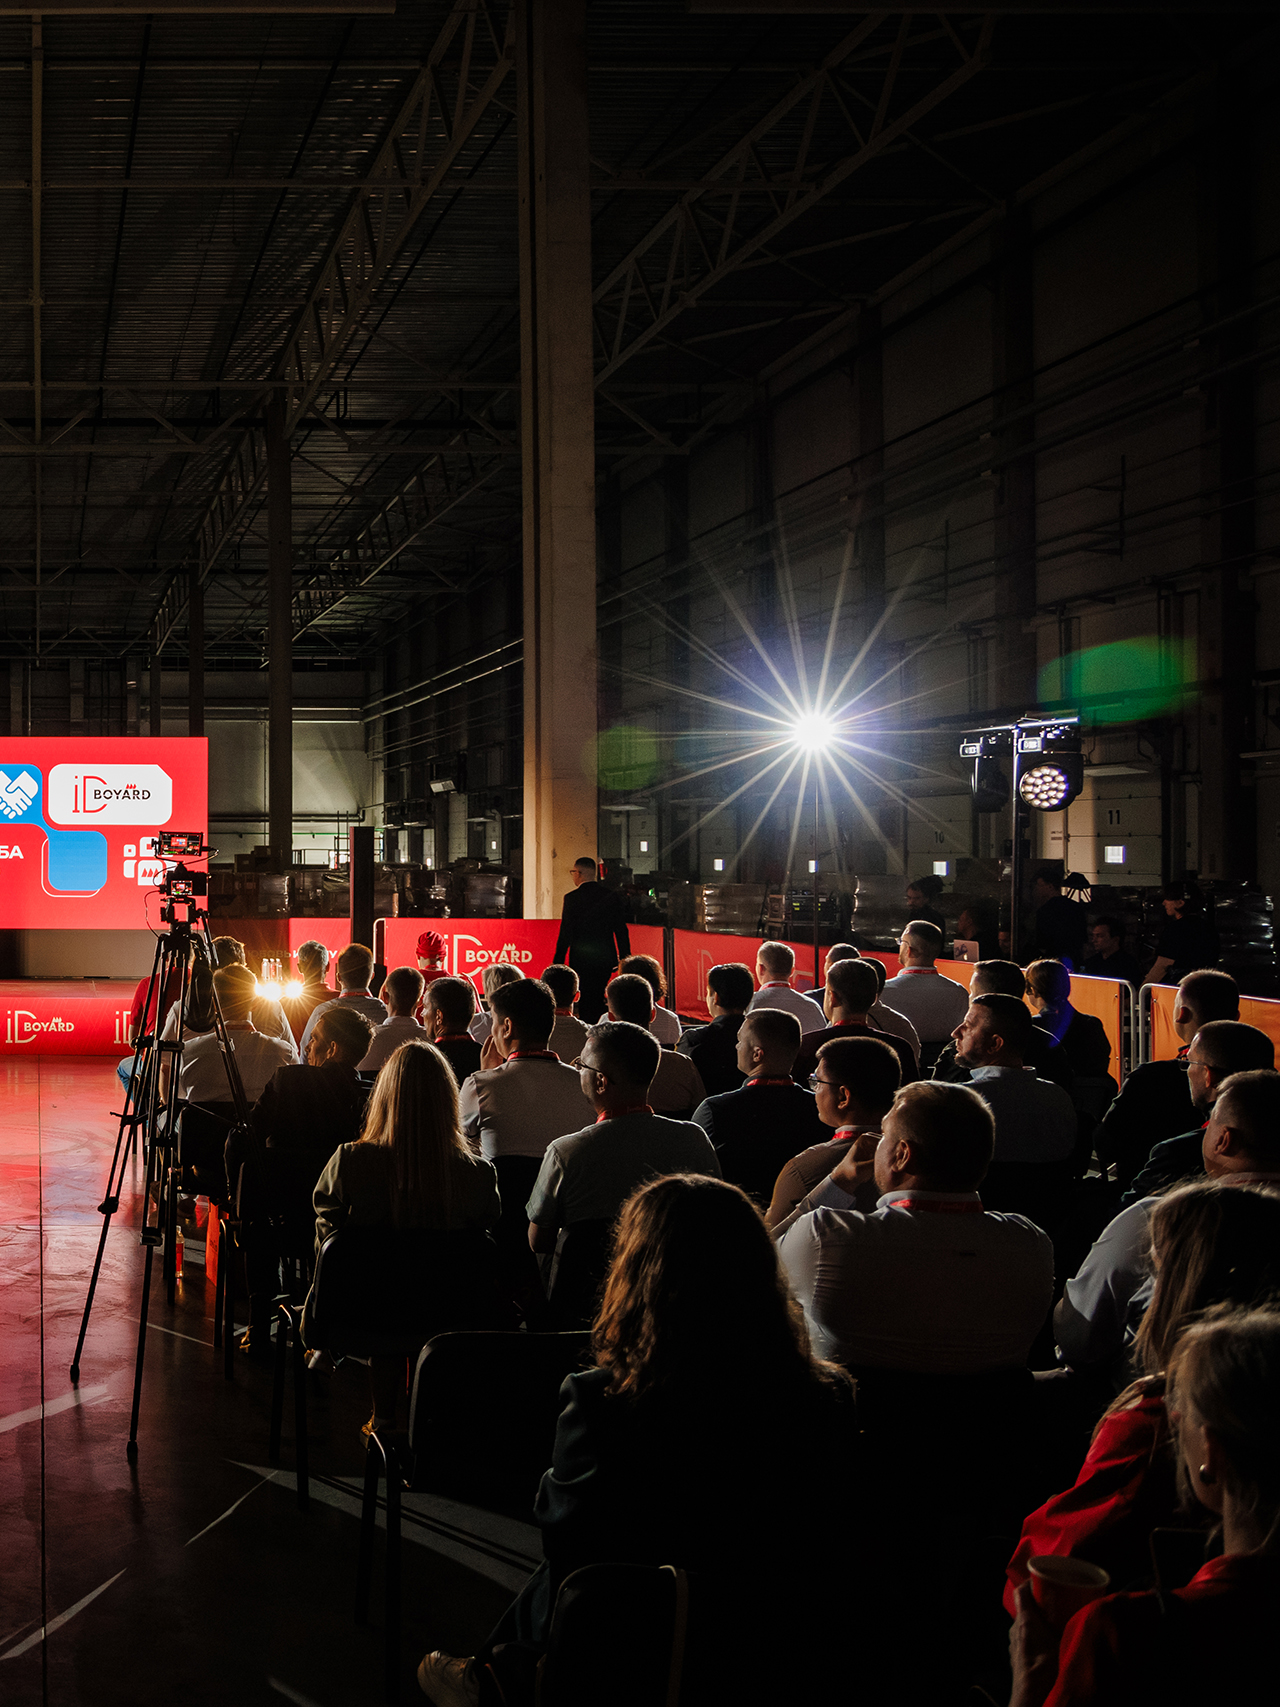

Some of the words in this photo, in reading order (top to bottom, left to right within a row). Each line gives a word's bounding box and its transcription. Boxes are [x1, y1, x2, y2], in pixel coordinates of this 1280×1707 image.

[93, 789, 151, 800] BOYARD
[1108, 809, 1120, 825] 11
[934, 831, 945, 844] 10
[465, 950, 533, 963] BOYARD
[24, 1022, 75, 1032] BOYARD
